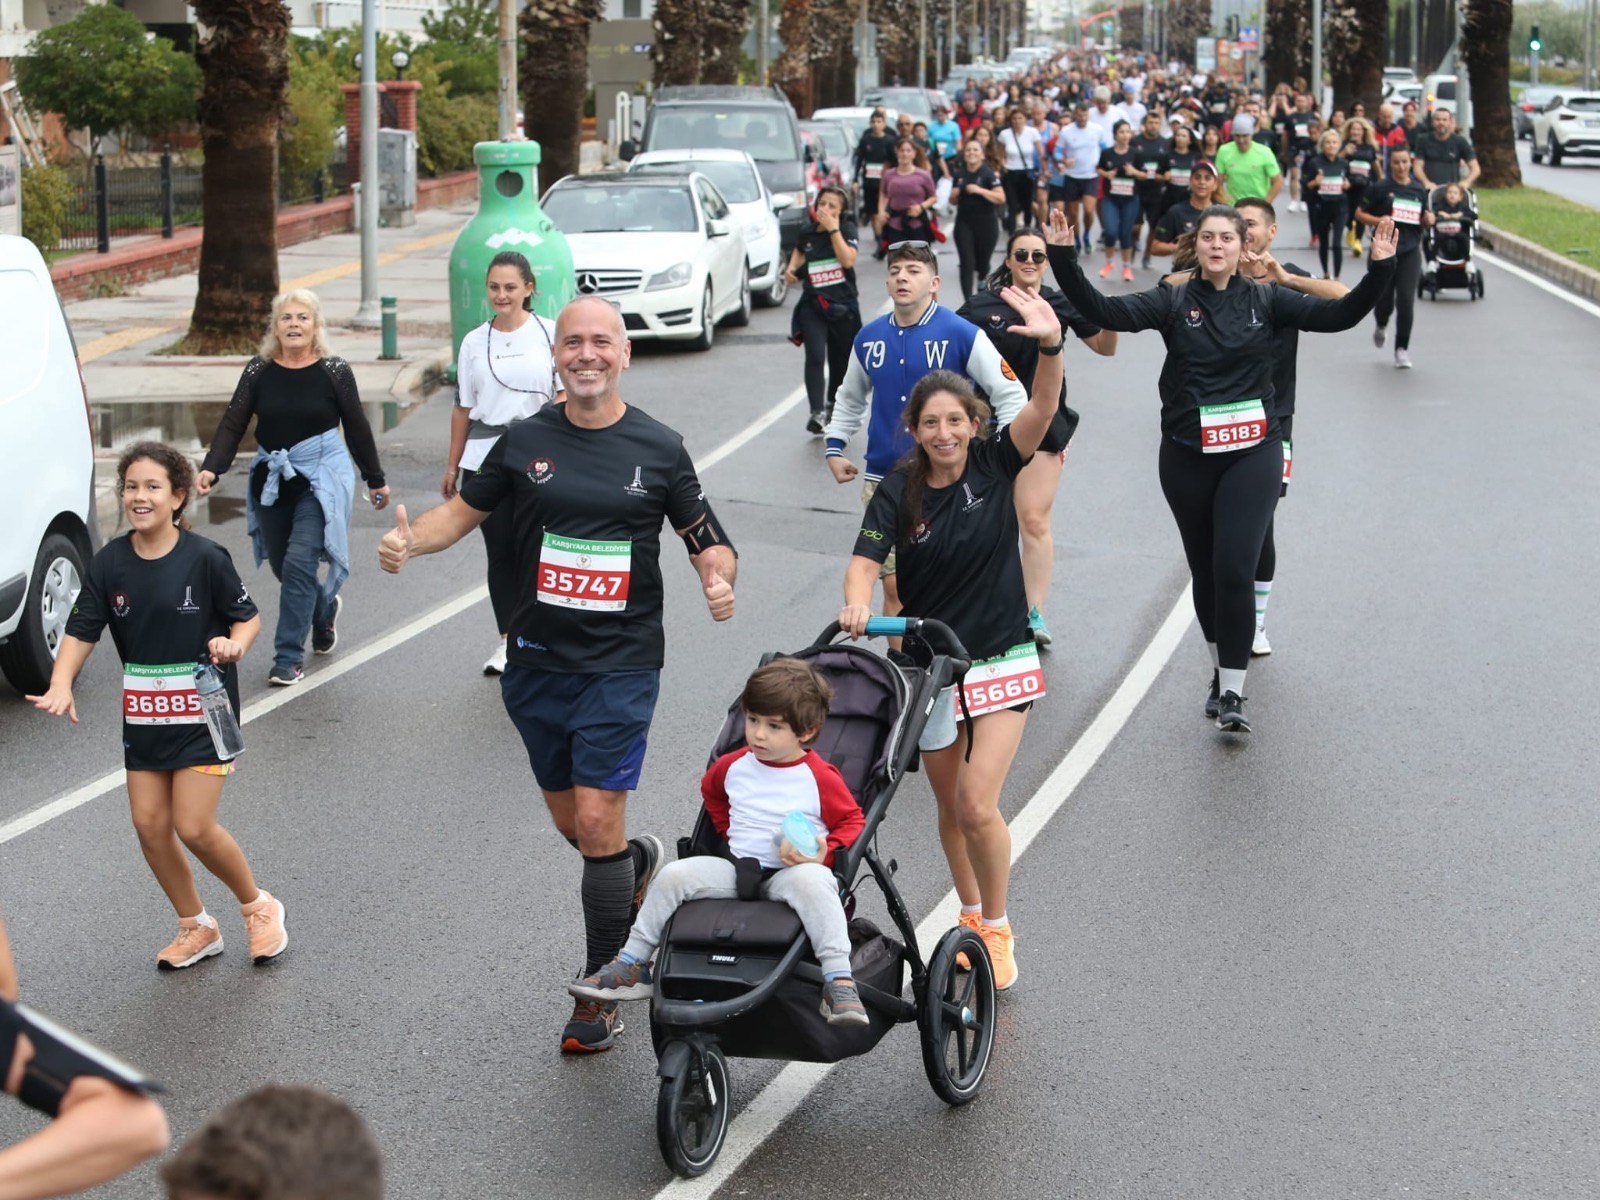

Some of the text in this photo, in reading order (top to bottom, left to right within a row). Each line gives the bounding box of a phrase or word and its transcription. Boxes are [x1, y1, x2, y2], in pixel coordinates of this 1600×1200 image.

[862, 339, 886, 370] 79
[923, 339, 949, 369] W
[1206, 423, 1261, 444] 36183
[552, 539, 630, 552] KARŞIYAKA BELEDİYESİ
[543, 568, 623, 596] 35747
[131, 667, 163, 675] KARŞIYAKA
[126, 693, 202, 713] 36885
